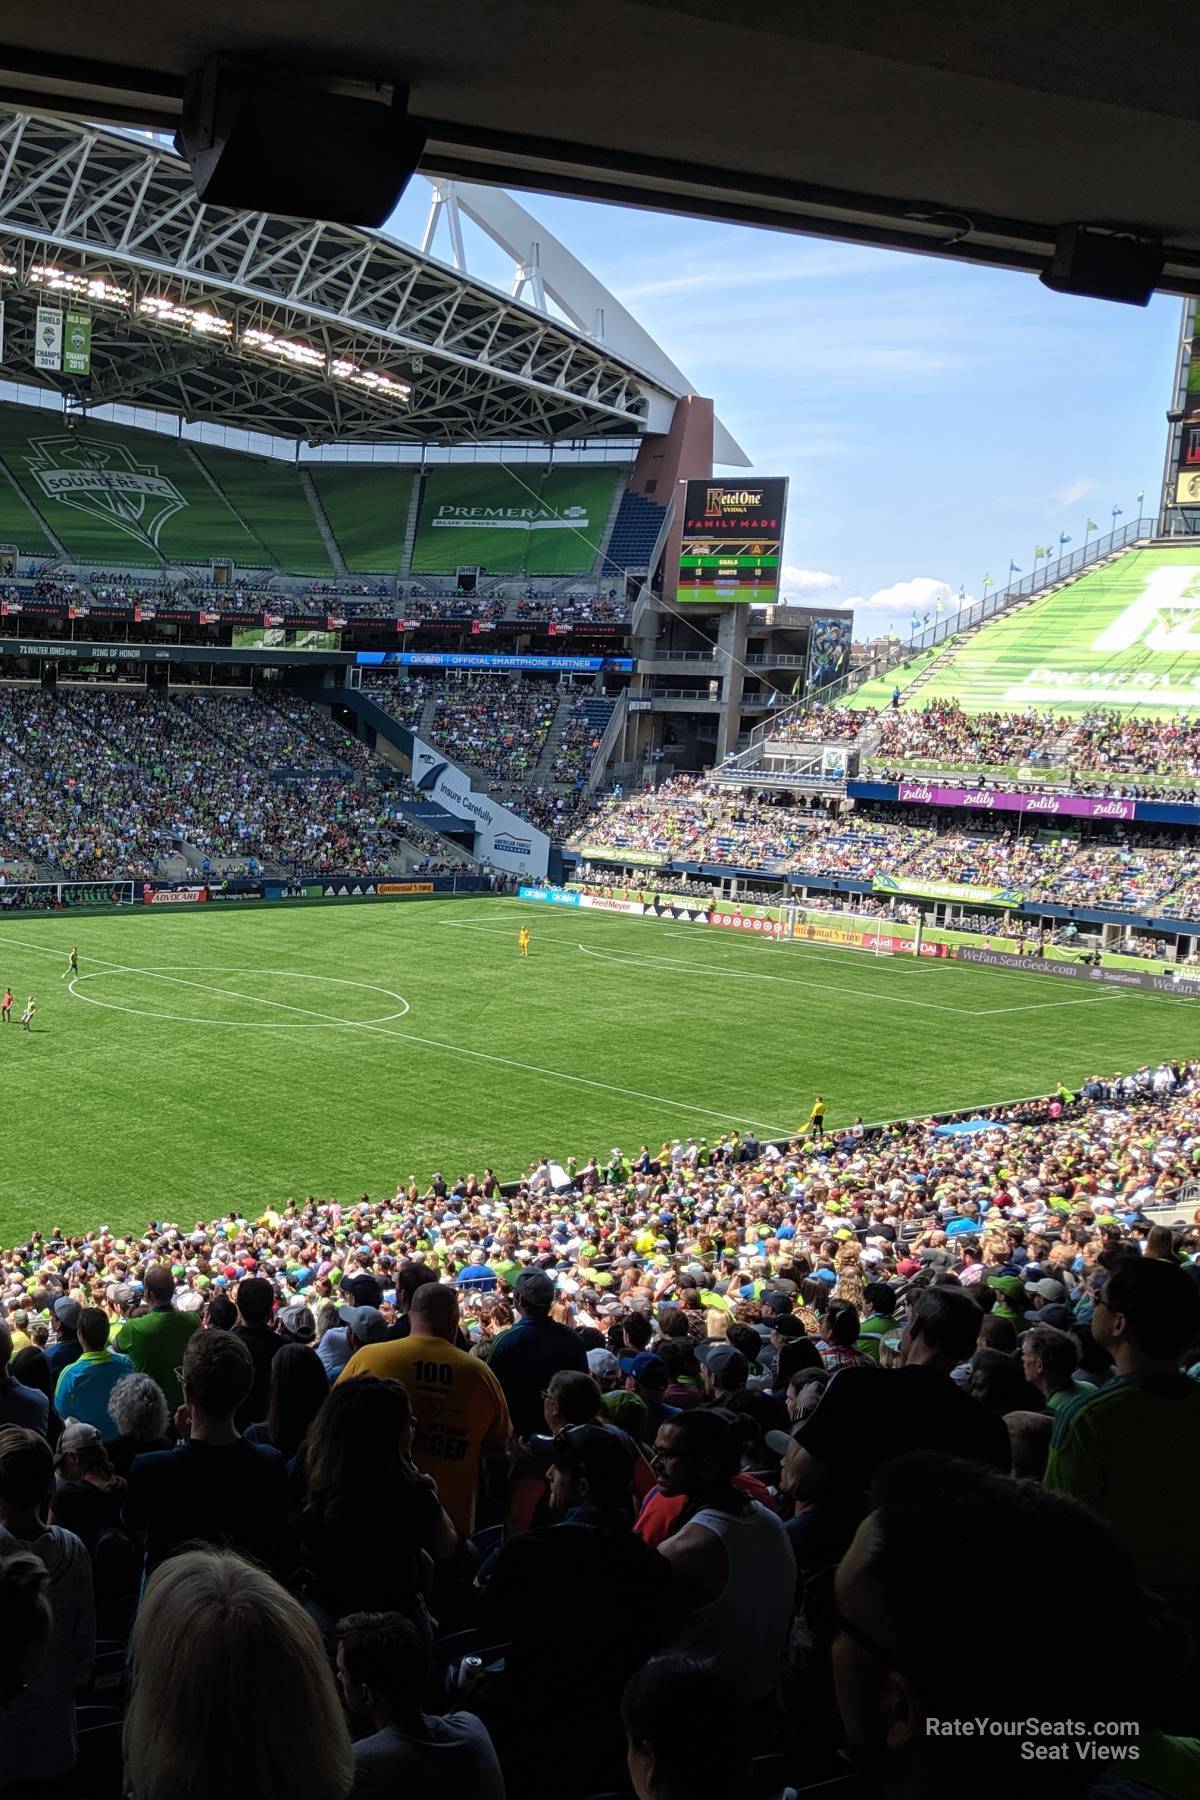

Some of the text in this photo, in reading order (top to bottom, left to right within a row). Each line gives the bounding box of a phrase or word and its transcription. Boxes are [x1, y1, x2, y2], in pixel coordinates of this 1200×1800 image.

[39, 315, 61, 326] SHIELD
[36, 349, 61, 360] CHAMPS
[145, 484, 174, 496] FC
[704, 488, 762, 517] Ketel One
[436, 505, 549, 519] PREMERA
[687, 520, 777, 528] FAMILY MADE
[19, 645, 66, 656] 71 WALTER JONES
[92, 648, 141, 658] RING OF HONOR
[410, 654, 590, 668] alcatel OFFICIAL SMARTPHONE PARTNER
[1024, 669, 1170, 686] PREMERA
[903, 784, 933, 802] zulily
[963, 791, 995, 808] zulily
[440, 782, 494, 825] Insure Carefully
[1026, 795, 1060, 812] zulily
[1093, 801, 1128, 818] zulily
[494, 838, 531, 849] AMERICAN FAMILY
[379, 883, 413, 893] Continental
[151, 892, 200, 902] ADVOCARE
[870, 937, 893, 948] Audi
[961, 949, 1078, 977] WeFan.SeatGeek.com
[1103, 971, 1142, 985] SeatGeek
[413, 1360, 453, 1385] 100
